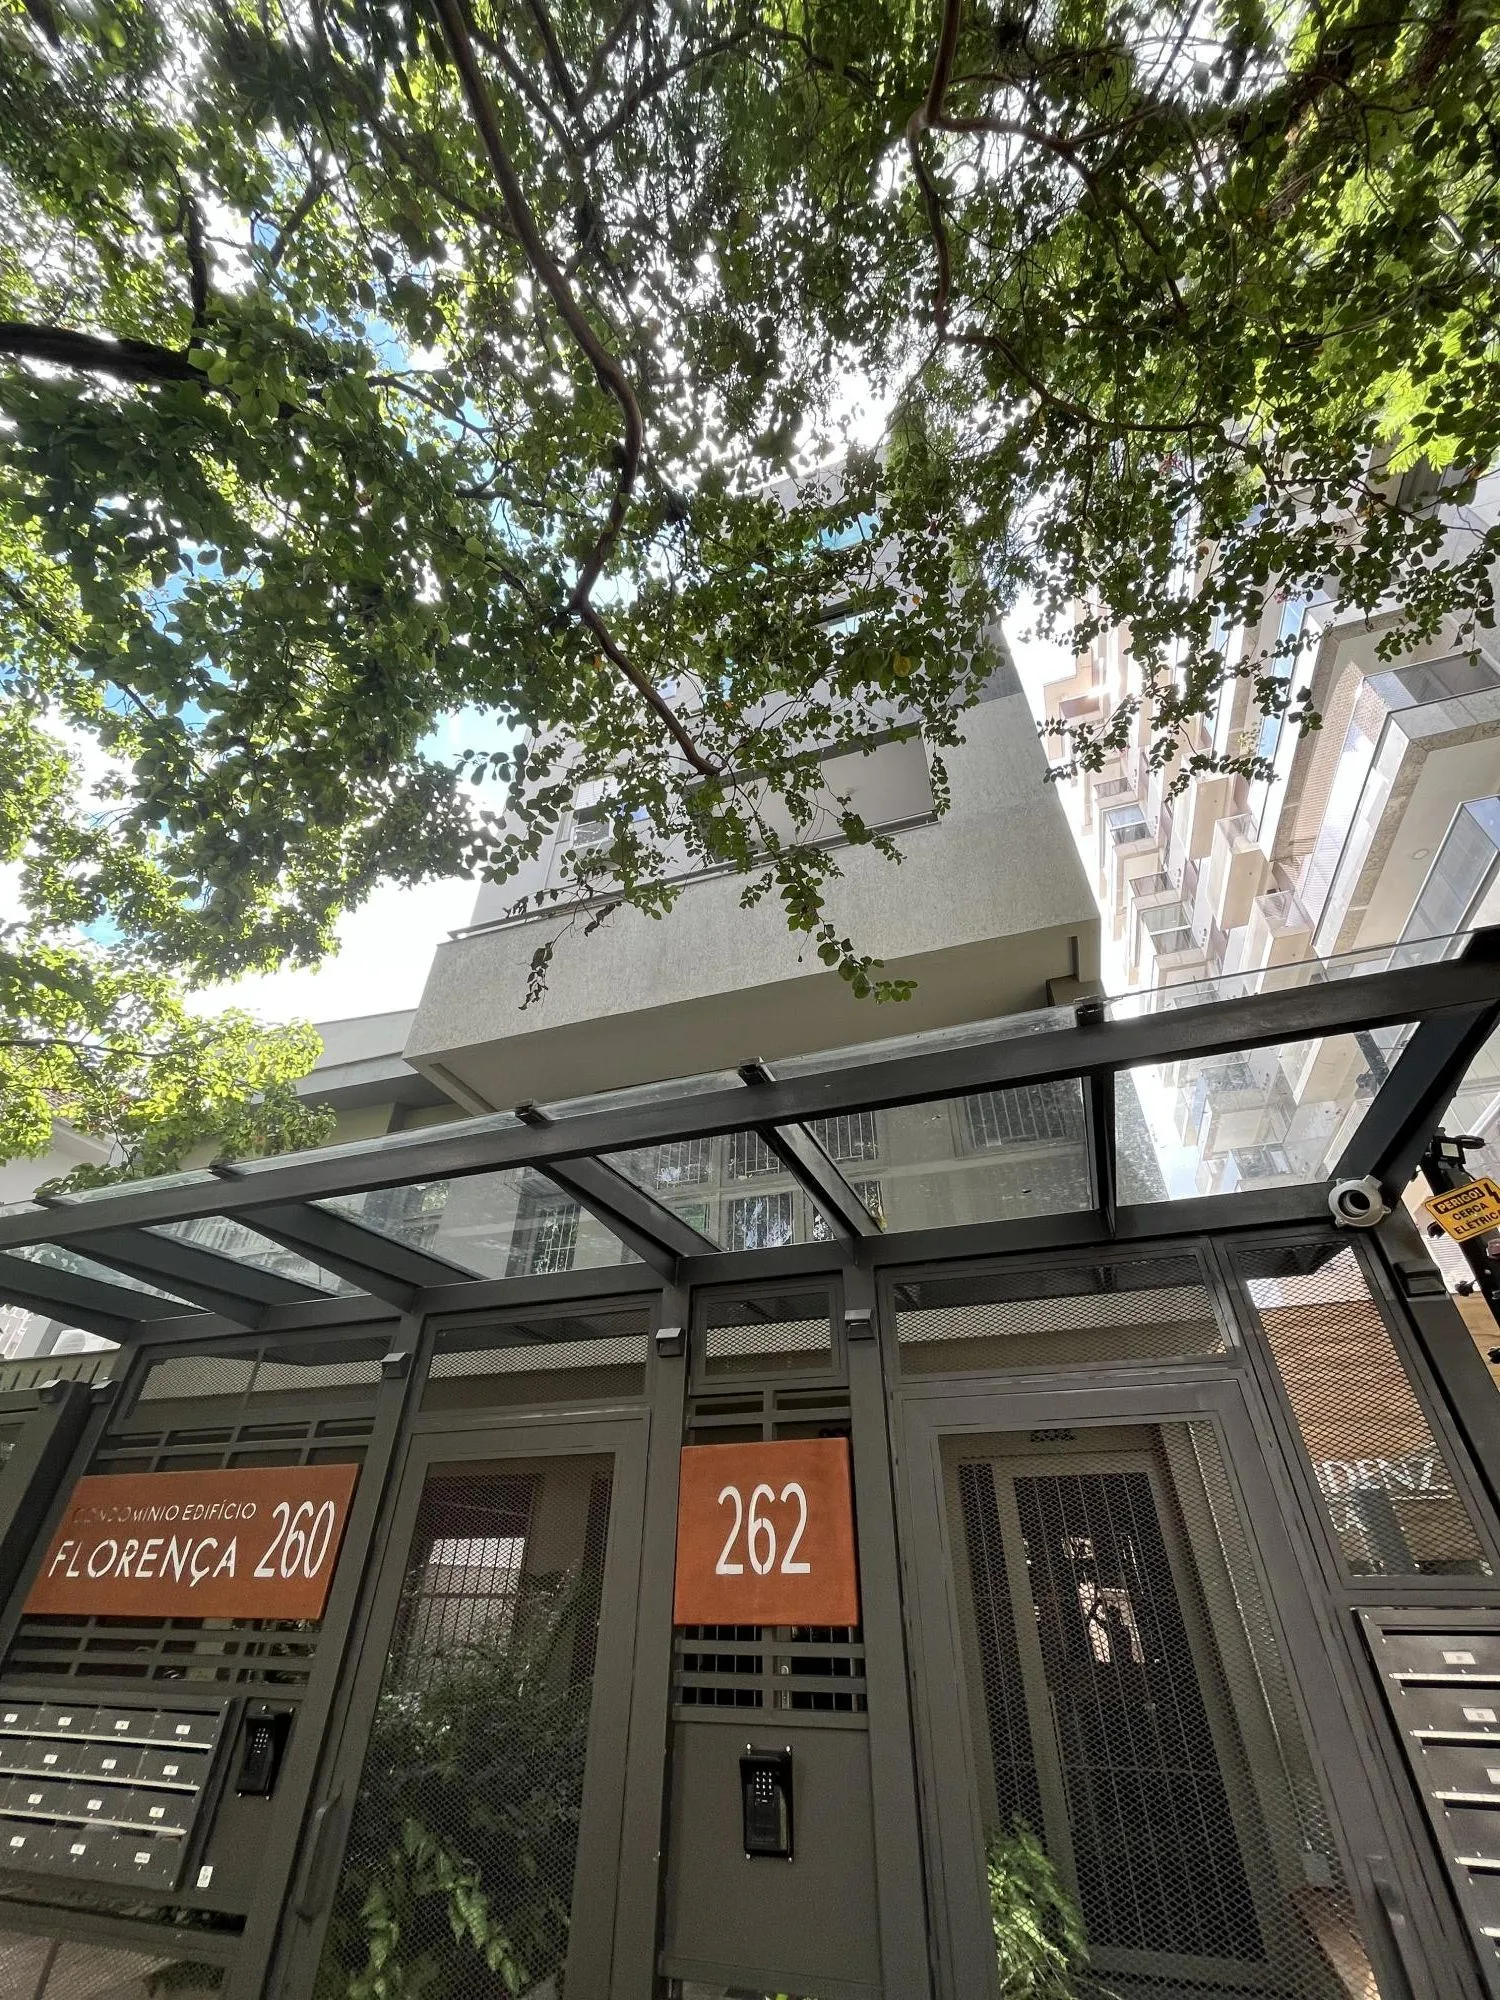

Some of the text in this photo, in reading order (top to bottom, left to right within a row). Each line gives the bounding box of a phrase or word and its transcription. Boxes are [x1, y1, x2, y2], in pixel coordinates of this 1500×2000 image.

[1437, 1189, 1483, 1212] PERIGO!
[1453, 1204, 1490, 1221] CERCA
[181, 1499, 257, 1522] EDIFÍCIO
[714, 1482, 811, 1575] 262
[253, 1500, 336, 1579] 260
[47, 1534, 238, 1588] FLORENÇA
